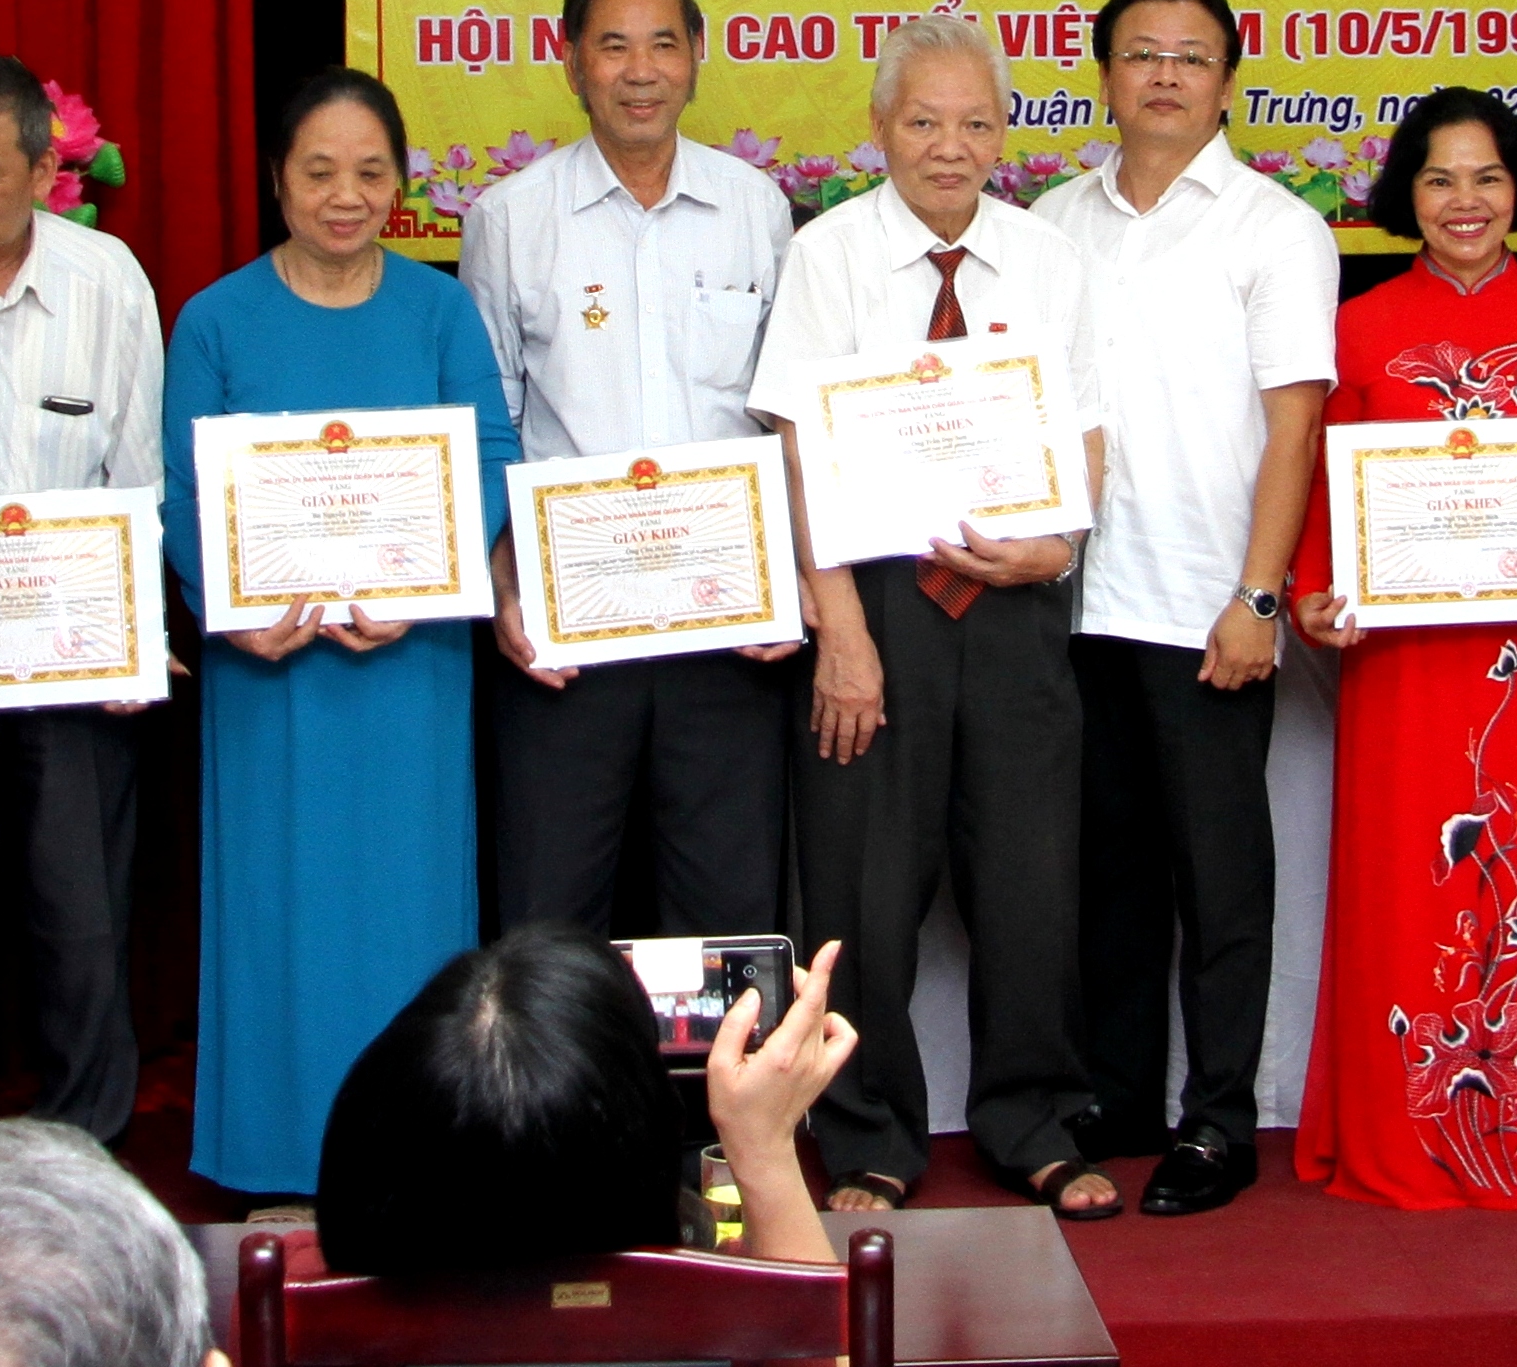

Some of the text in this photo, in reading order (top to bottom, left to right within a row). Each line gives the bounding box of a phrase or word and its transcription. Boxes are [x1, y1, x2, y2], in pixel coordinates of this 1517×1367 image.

[420, 9, 511, 72] HỘI
[728, 15, 835, 60] CAO
[997, 4, 1101, 67] VIỆ
[1244, 89, 1365, 133] Trưng,
[936, 419, 974, 433] KHEN
[302, 491, 380, 508] GIẤY KHEN
[1427, 494, 1503, 511] GIẤY KHEN
[613, 525, 690, 544] GIẤY KHEN
[17, 575, 58, 589] KHEN
